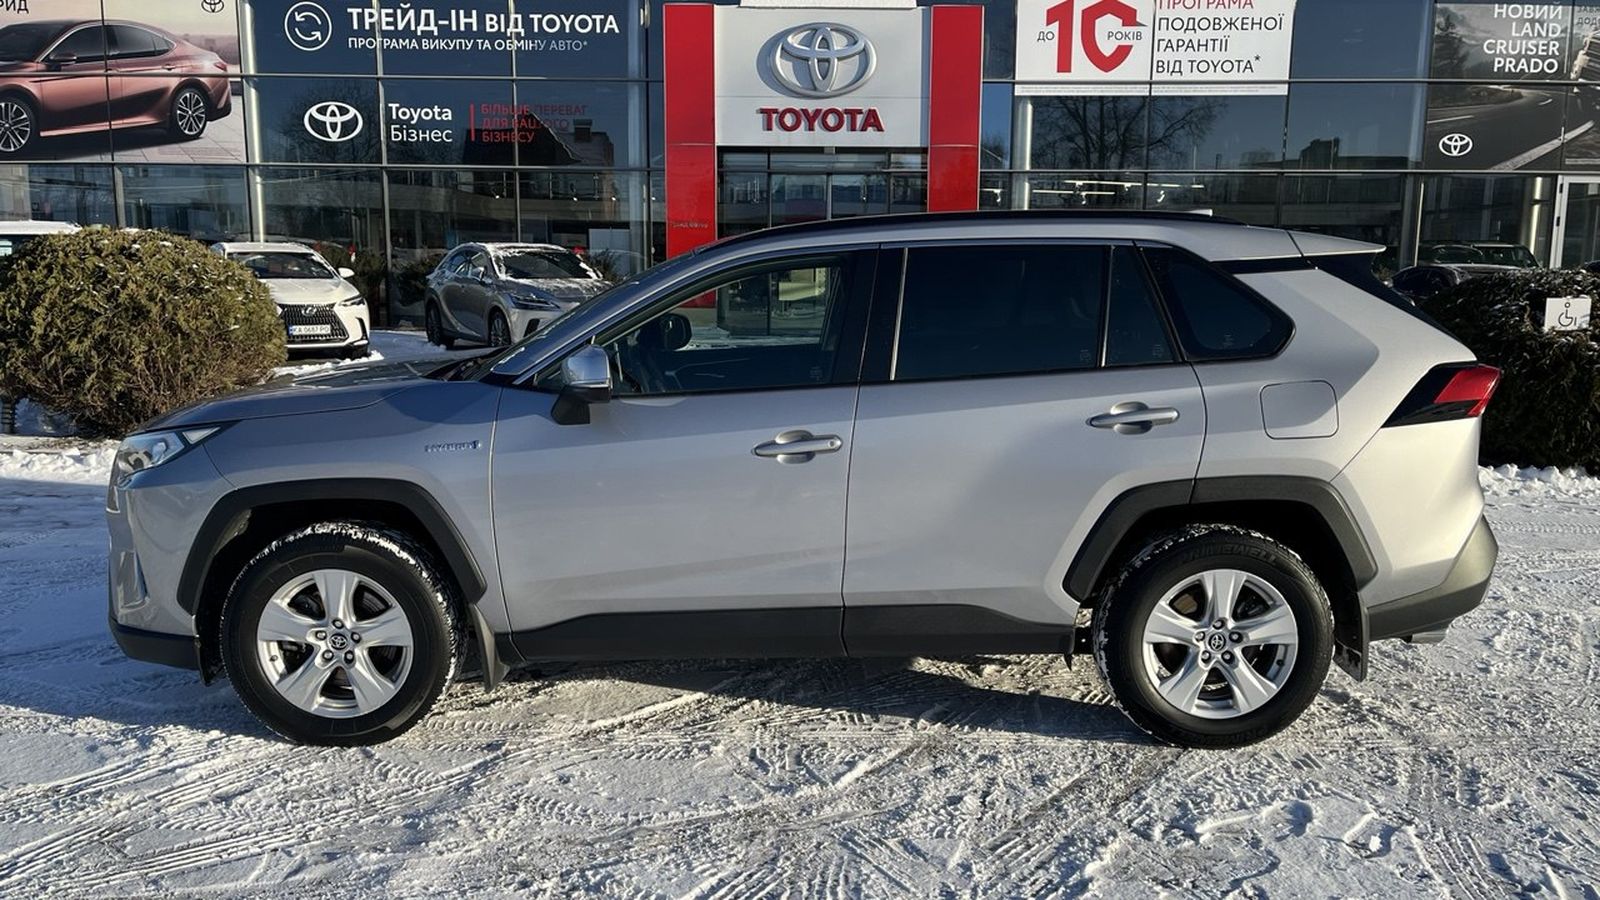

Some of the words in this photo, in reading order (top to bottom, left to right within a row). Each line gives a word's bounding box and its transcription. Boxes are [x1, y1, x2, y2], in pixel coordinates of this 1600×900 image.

[1159, 0, 1255, 10] ПРОГРАМА
[1493, 1, 1562, 19] НОВИЙ
[347, 3, 478, 35] ТРЕЙД-ІН
[485, 13, 525, 36] ВІД
[529, 14, 620, 34] TOYOTA
[1157, 13, 1285, 33] ПОДОВЖЕНОЇ
[1037, 31, 1055, 43] ДО
[1107, 31, 1143, 41] РОКІВ
[1511, 21, 1561, 37] LAND
[348, 37, 419, 50] ПРОГРАМА
[422, 39, 475, 51] ВИКУПУ
[476, 39, 492, 51] ТА
[494, 39, 547, 52] ОБМІНУ
[1156, 35, 1231, 53] ГАРАНТІЇ
[1483, 39, 1560, 55] CRUISER
[1155, 60, 1183, 76] ВІД
[1493, 57, 1559, 74] PRADO
[388, 103, 453, 124] Toyota
[758, 107, 885, 132] TOYOTA
[390, 124, 453, 142] Бізнес
[481, 131, 535, 143] БІЗНЕСУ
